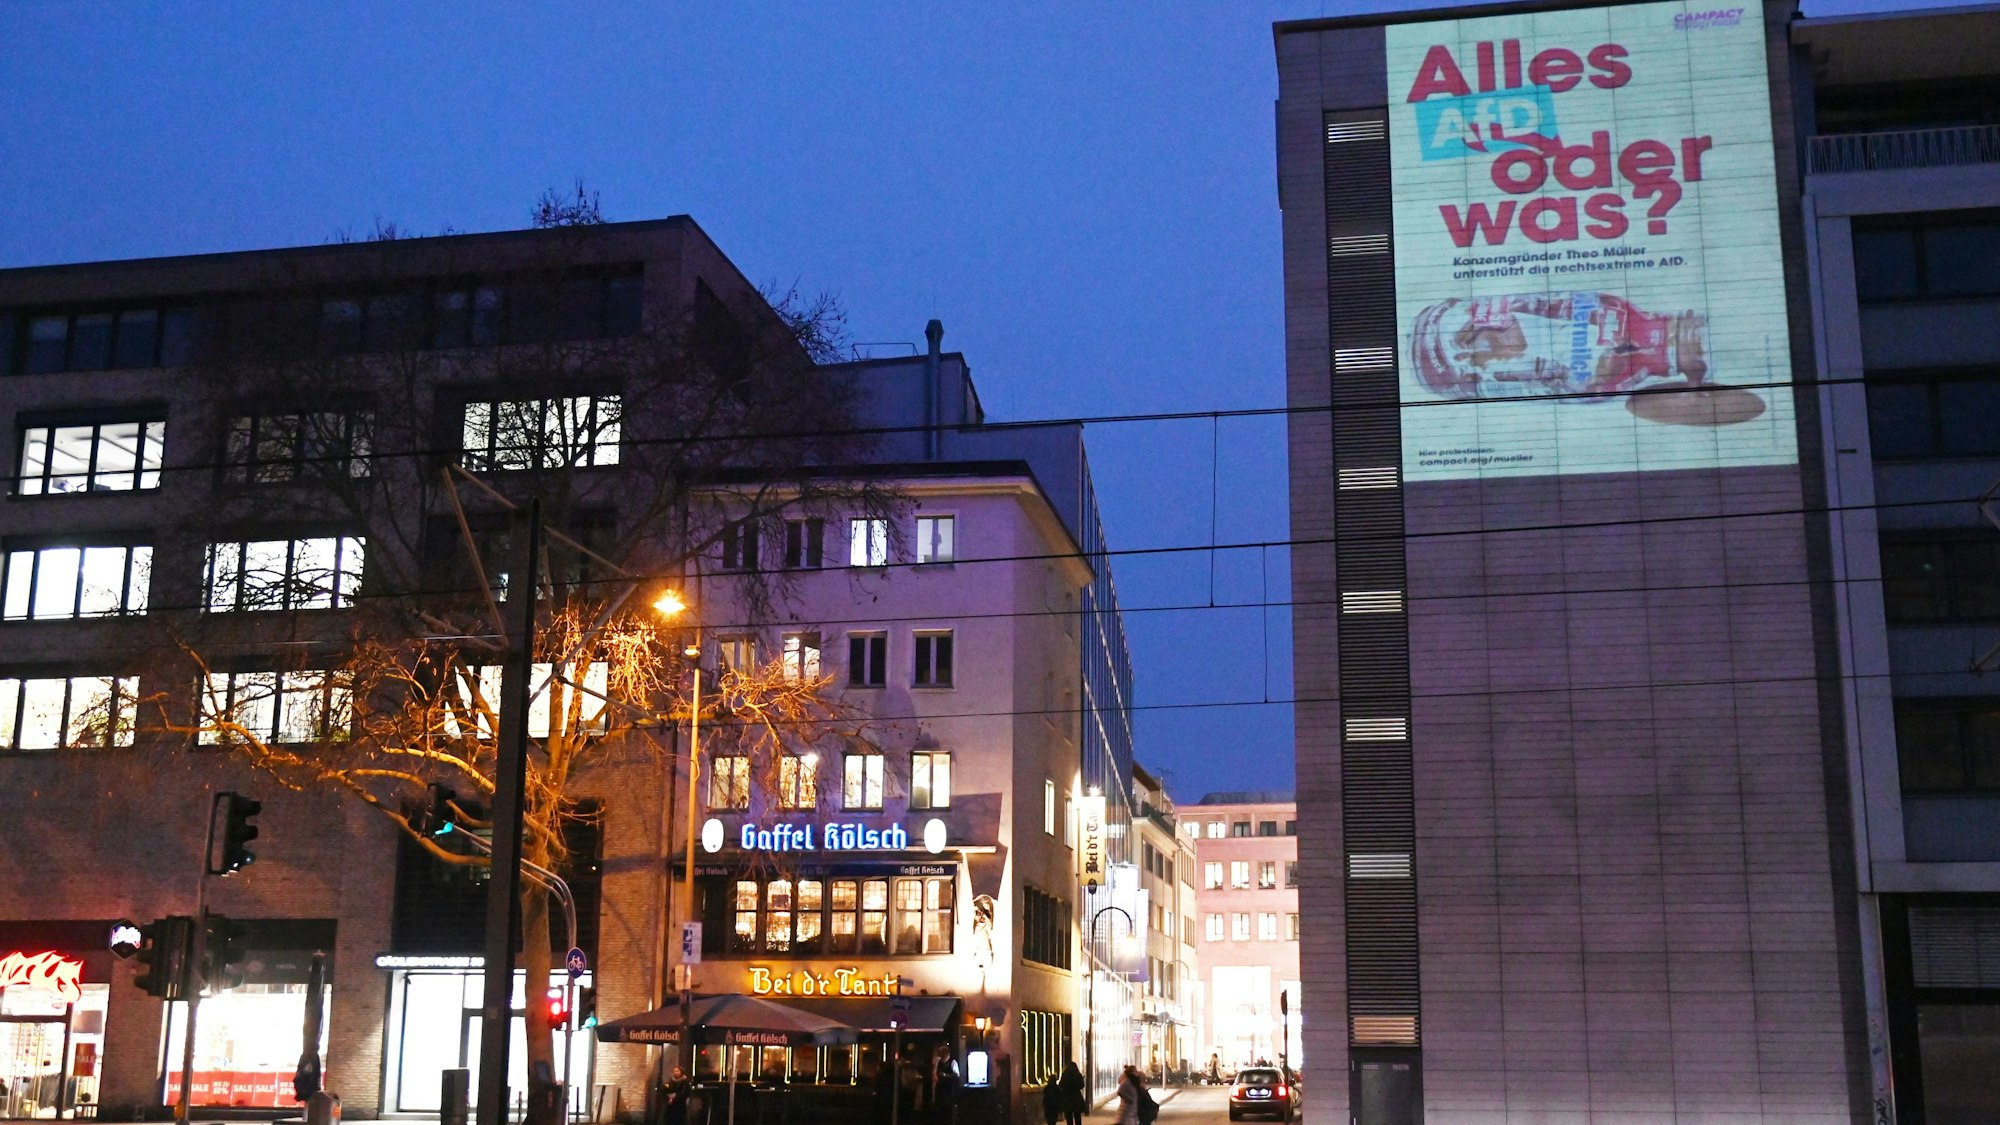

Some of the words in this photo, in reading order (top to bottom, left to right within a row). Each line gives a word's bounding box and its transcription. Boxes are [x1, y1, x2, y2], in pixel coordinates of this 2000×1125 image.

[1674, 8, 1744, 23] CAMPACT
[1406, 39, 1632, 103] Alles
[1491, 131, 1713, 195] oder
[1439, 181, 1683, 247] was?
[1566, 249, 1600, 260] Theo
[1603, 246, 1647, 258] Müller
[1453, 266, 1525, 280] unterstützt
[1528, 264, 1551, 275] die
[1555, 258, 1655, 274] rechtsextreme
[741, 823, 816, 852] Gaffel
[824, 822, 908, 850] Kölsch
[749, 967, 793, 995] Bei
[834, 967, 898, 996] Tant
[629, 1030, 653, 1041] Gaffel
[736, 1033, 759, 1043] Gaffel
[760, 1034, 788, 1044] Kölsch
[233, 1084, 252, 1092] SALE
[256, 1084, 275, 1092] SALE
